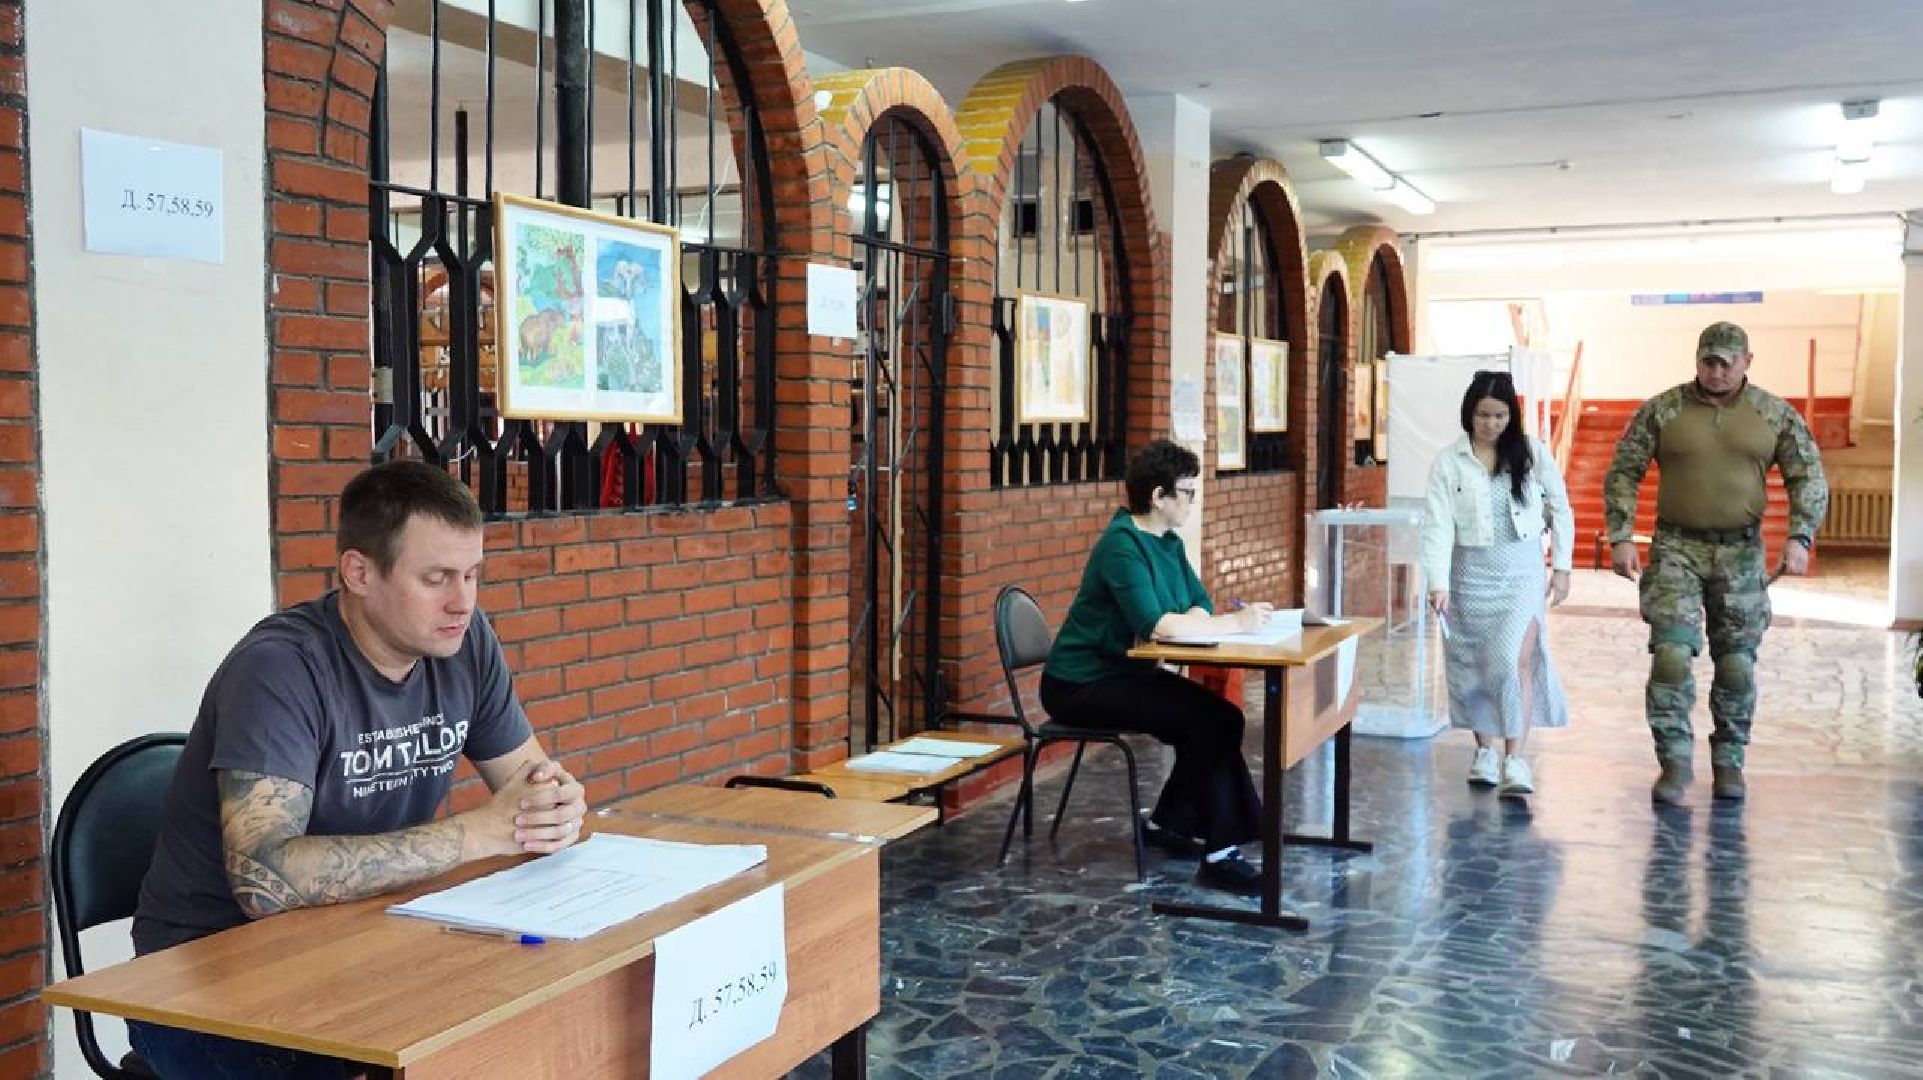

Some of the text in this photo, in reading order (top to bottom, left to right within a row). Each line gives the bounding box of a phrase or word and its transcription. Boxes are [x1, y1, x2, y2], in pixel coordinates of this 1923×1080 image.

[121, 188, 214, 218] Д. 57,58,59
[340, 744, 393, 777] TOM
[395, 720, 469, 767] TALOR
[358, 722, 422, 745] ESTABSHE
[688, 960, 777, 1030] Д. 57,58,59
